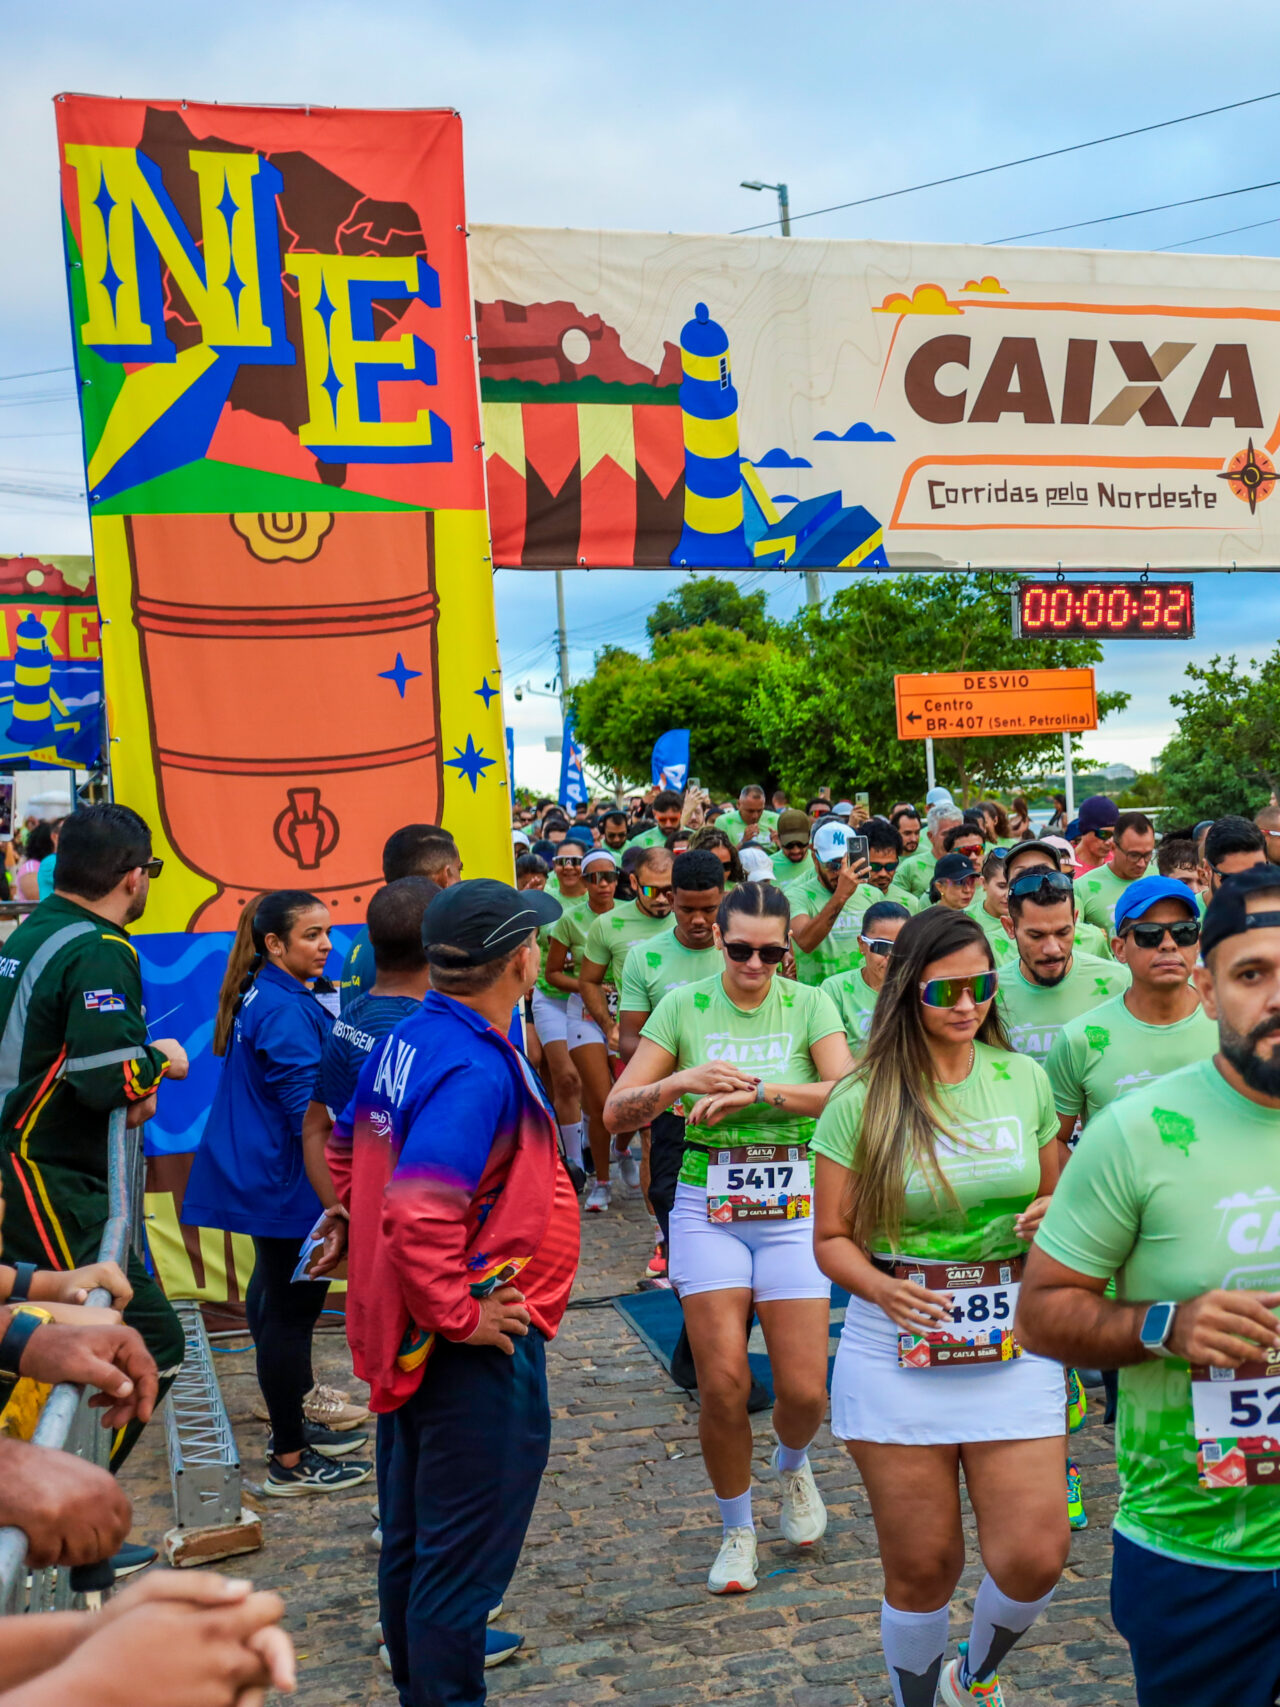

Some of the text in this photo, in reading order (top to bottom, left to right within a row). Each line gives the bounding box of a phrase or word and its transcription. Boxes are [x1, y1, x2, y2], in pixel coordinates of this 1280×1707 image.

[904, 334, 1264, 429] CAIXA
[928, 479, 1217, 510] Corridas pelo Nordeste
[1023, 588, 1185, 626] 00:00:32
[964, 675, 1030, 690] DESVIO
[924, 699, 974, 713] Centro
[926, 711, 1091, 731] BR-407 (Sent. Petrolina)
[707, 1041, 785, 1063] CAIXA
[747, 1147, 773, 1156] CAIXA
[727, 1167, 793, 1190] 5417
[947, 1269, 981, 1280] CAIXA
